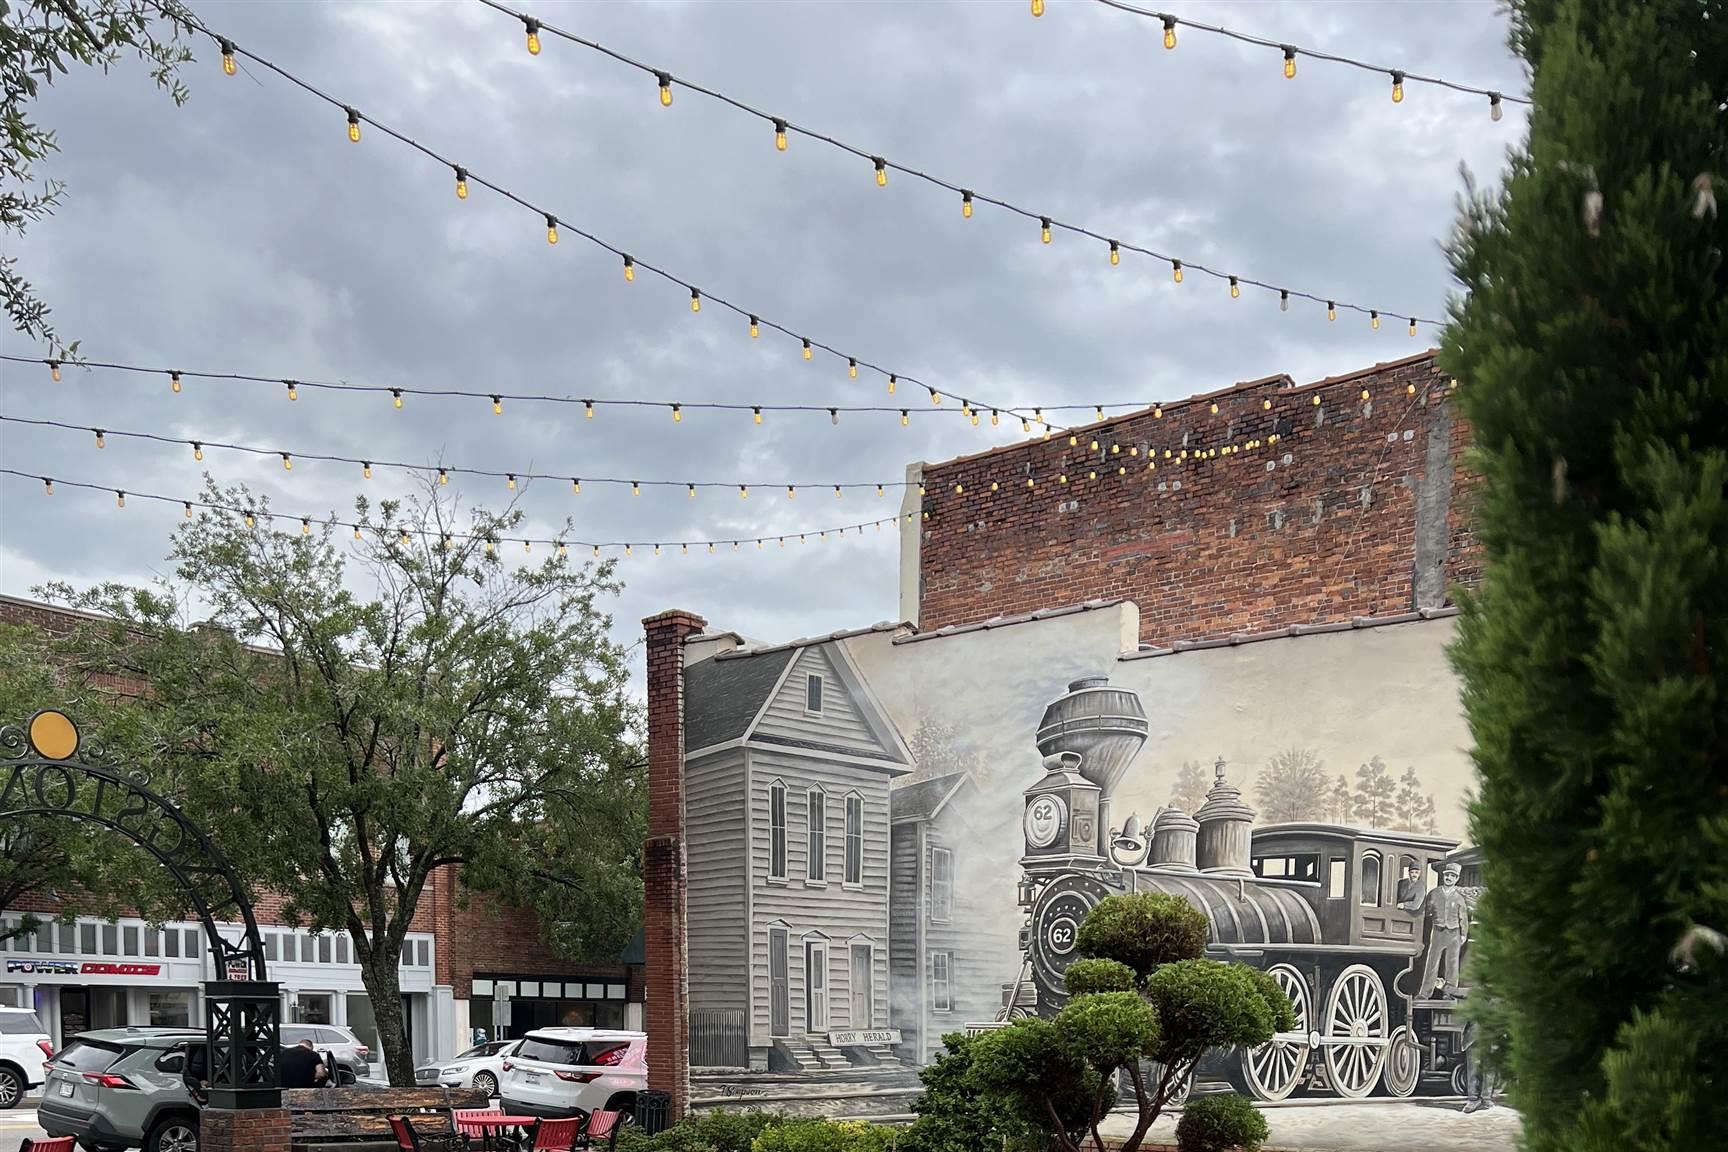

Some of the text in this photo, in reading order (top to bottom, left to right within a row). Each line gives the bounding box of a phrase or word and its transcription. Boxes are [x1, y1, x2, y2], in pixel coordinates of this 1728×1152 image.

[1034, 805, 1052, 820] 62
[1053, 928, 1071, 943] 62
[7, 960, 161, 976] POWER COMICS
[835, 1032, 891, 1042] HORRY HERALD
